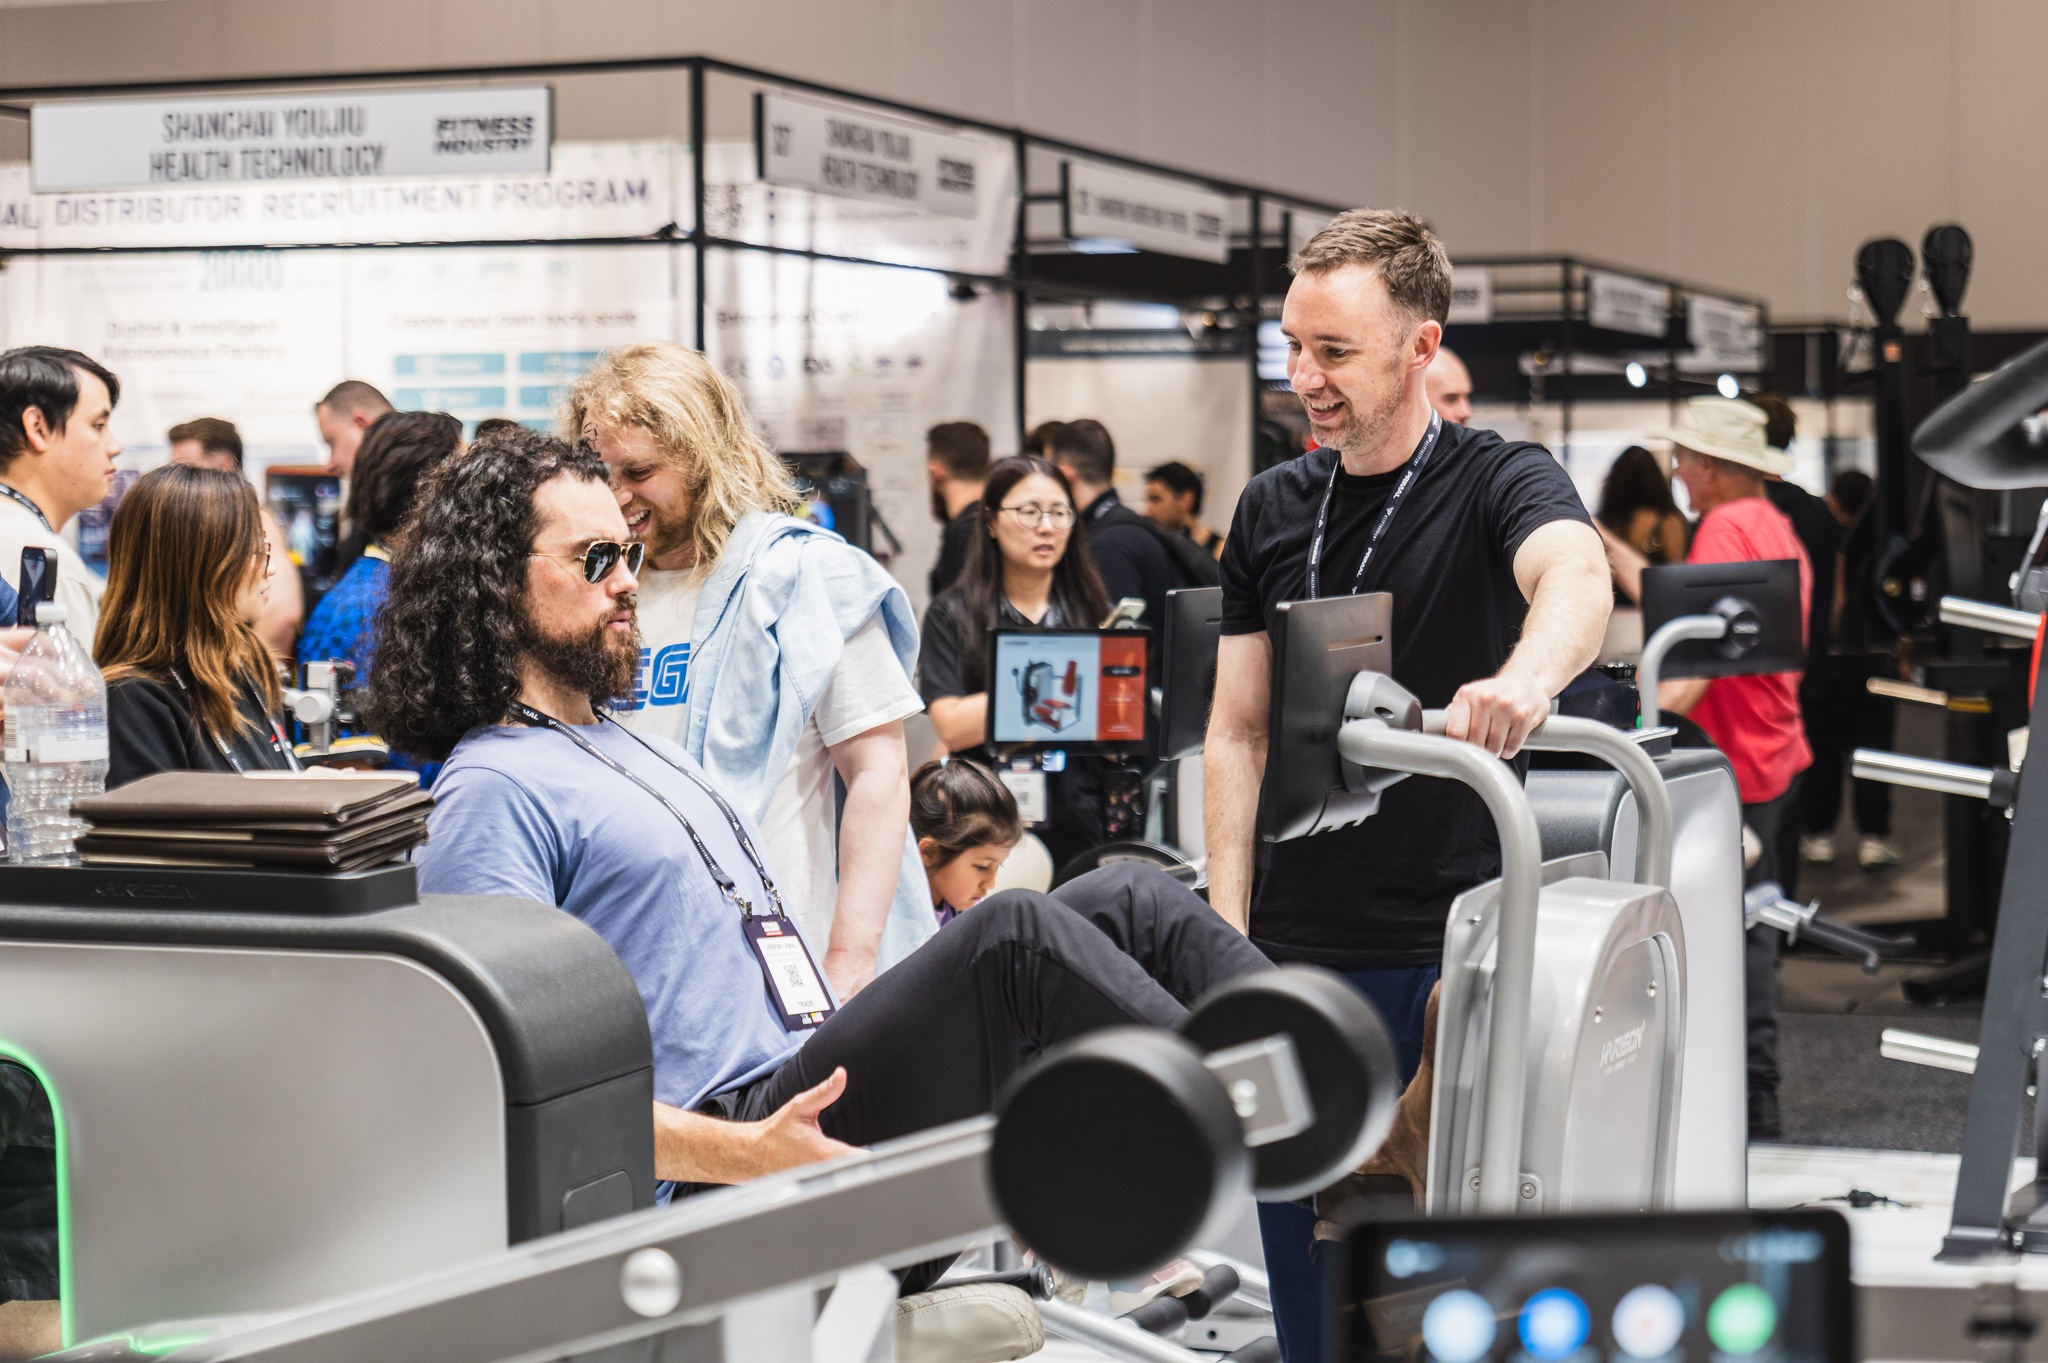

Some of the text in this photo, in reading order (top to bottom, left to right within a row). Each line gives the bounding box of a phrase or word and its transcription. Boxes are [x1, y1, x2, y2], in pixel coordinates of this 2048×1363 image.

[163, 105, 367, 143] SHANGHAI YOUJIU
[435, 116, 533, 137] FITNESS
[150, 146, 386, 183] HEALTH TECHNOLOGY
[55, 196, 243, 227] DISTRIBUTOR
[262, 182, 481, 219] RECRUITMENT
[492, 178, 649, 211] PROGRAM
[1393, 470, 1413, 500] PRIMAL
[1356, 547, 1373, 578] PRIMAL
[588, 744, 616, 768] PRIMAL
